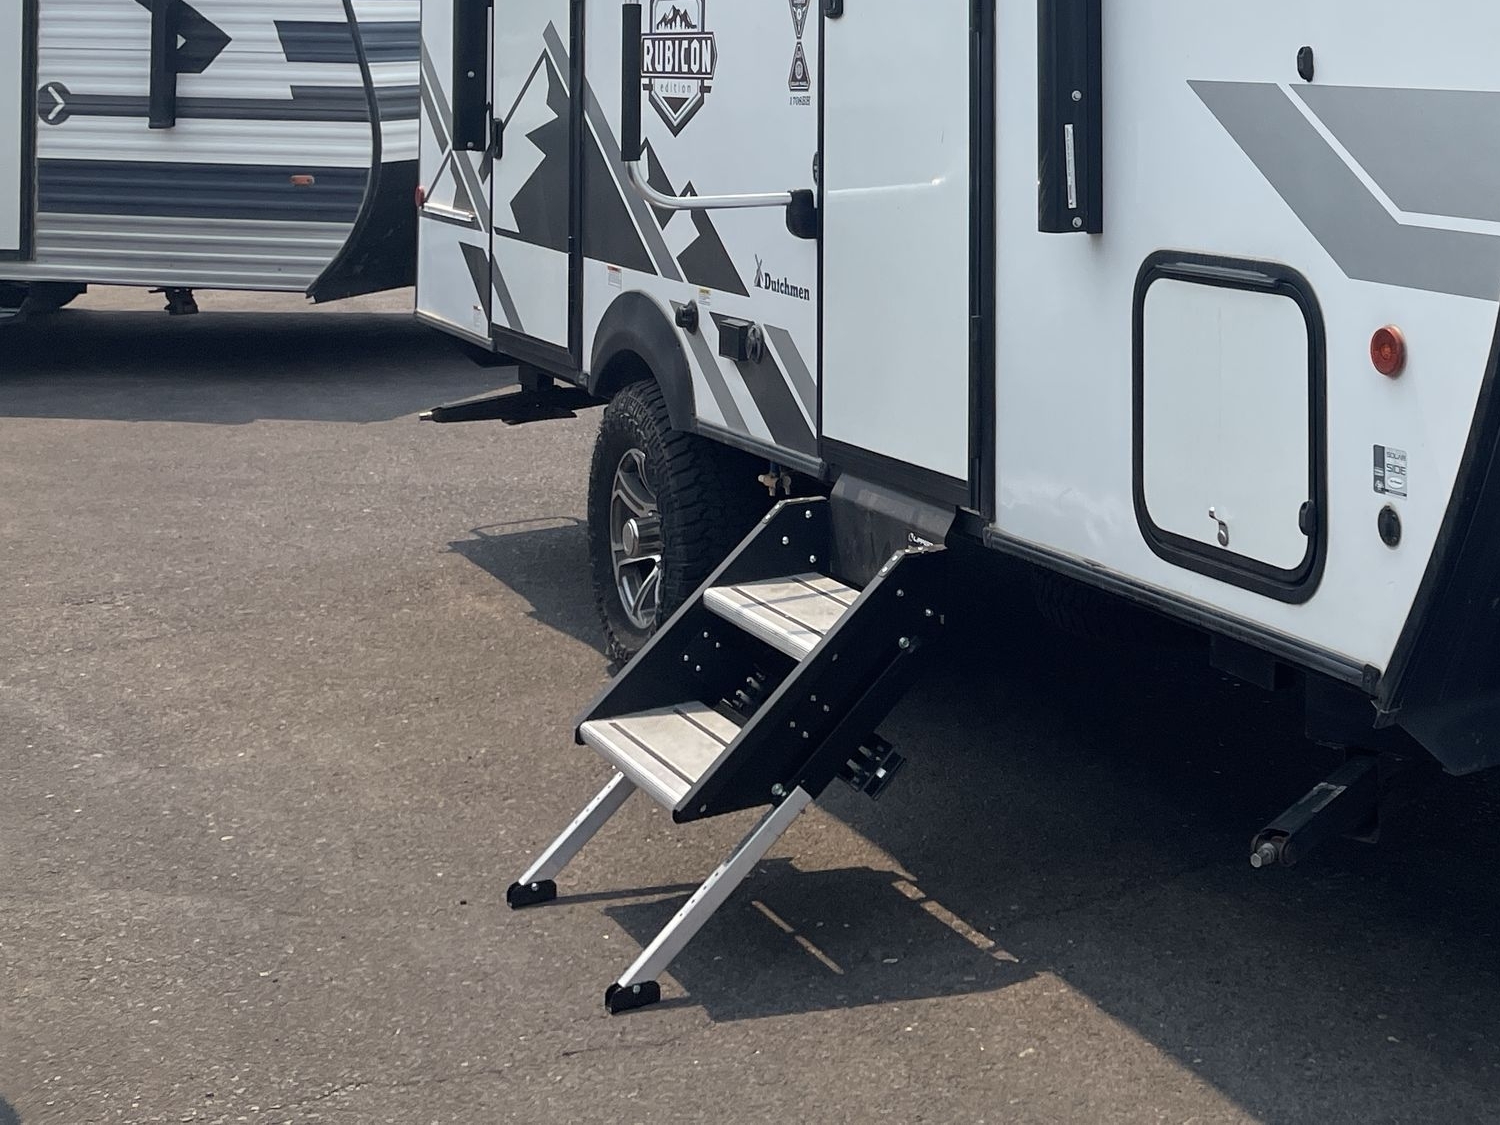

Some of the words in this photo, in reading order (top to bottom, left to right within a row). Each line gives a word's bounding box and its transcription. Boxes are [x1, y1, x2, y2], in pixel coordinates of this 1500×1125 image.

[643, 38, 711, 74] RUBICON
[660, 81, 692, 93] edition
[764, 272, 811, 301] Dutchmen
[1386, 463, 1407, 476] SIDE
